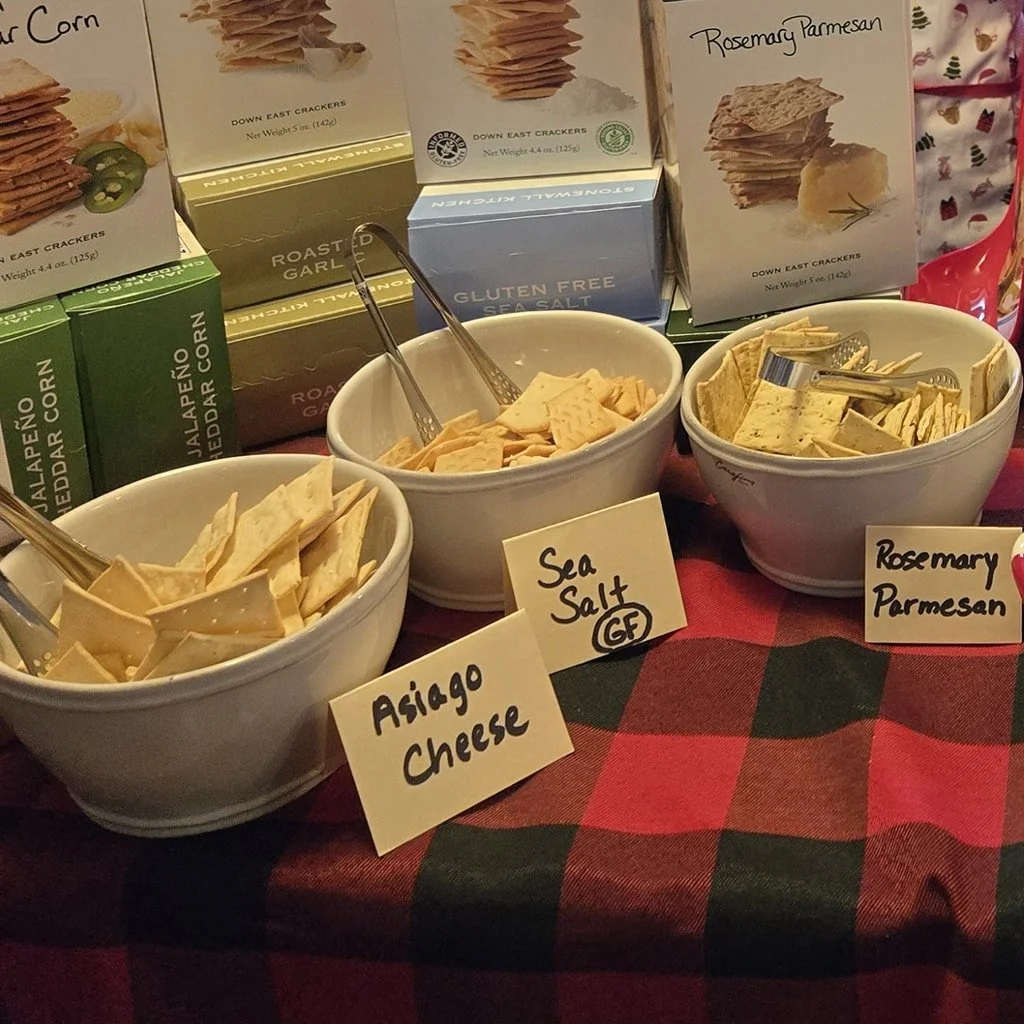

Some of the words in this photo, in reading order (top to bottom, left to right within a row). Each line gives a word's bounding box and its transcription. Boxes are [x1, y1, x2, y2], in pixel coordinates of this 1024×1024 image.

[27, 5, 99, 44] Corn
[689, 28, 797, 58] Rosemary
[782, 15, 882, 39] Parmesan
[231, 116, 262, 126] DOWN
[266, 110, 291, 120] EAST
[294, 100, 347, 115] CRACKERS
[246, 132, 261, 141] Net
[262, 127, 291, 138] Weight
[312, 117, 338, 129] (142g)
[428, 132, 465, 149] INFORMED
[473, 133, 503, 141] DOWN
[535, 127, 587, 137] CRACKERS
[293, 142, 405, 169] STONEWALL
[500, 147, 528, 157] Weight
[556, 144, 581, 154] (125g)
[203, 166, 288, 188] KITCHEN
[431, 195, 515, 209] KITCHEN
[522, 186, 636, 201] STONEWALL
[10, 248, 40, 261] EAST
[44, 230, 105, 252] CRACKERS
[70, 250, 99, 265] (125g)
[283, 252, 365, 280] GARLC
[751, 268, 782, 278] DOWN
[785, 262, 809, 272] EAST
[812, 252, 862, 267] CRACKERS
[454, 283, 547, 304] GLUTEN
[557, 276, 616, 292] FREE
[780, 279, 807, 289] Weight
[224, 301, 309, 326] KITCHEN
[536, 295, 592, 311] SALT
[191, 311, 212, 373] CORN
[37, 359, 60, 423] CORN
[171, 348, 202, 458] JALAPEÑO
[15, 397, 48, 513] JALAPEÑO
[538, 547, 597, 588] Sea
[876, 538, 999, 591] Rosemary
[551, 575, 628, 624] Salt
[872, 582, 1007, 617] Parmesan
[604, 610, 639, 646] GF
[372, 663, 483, 736] Asiago
[403, 705, 530, 786] Cheese
